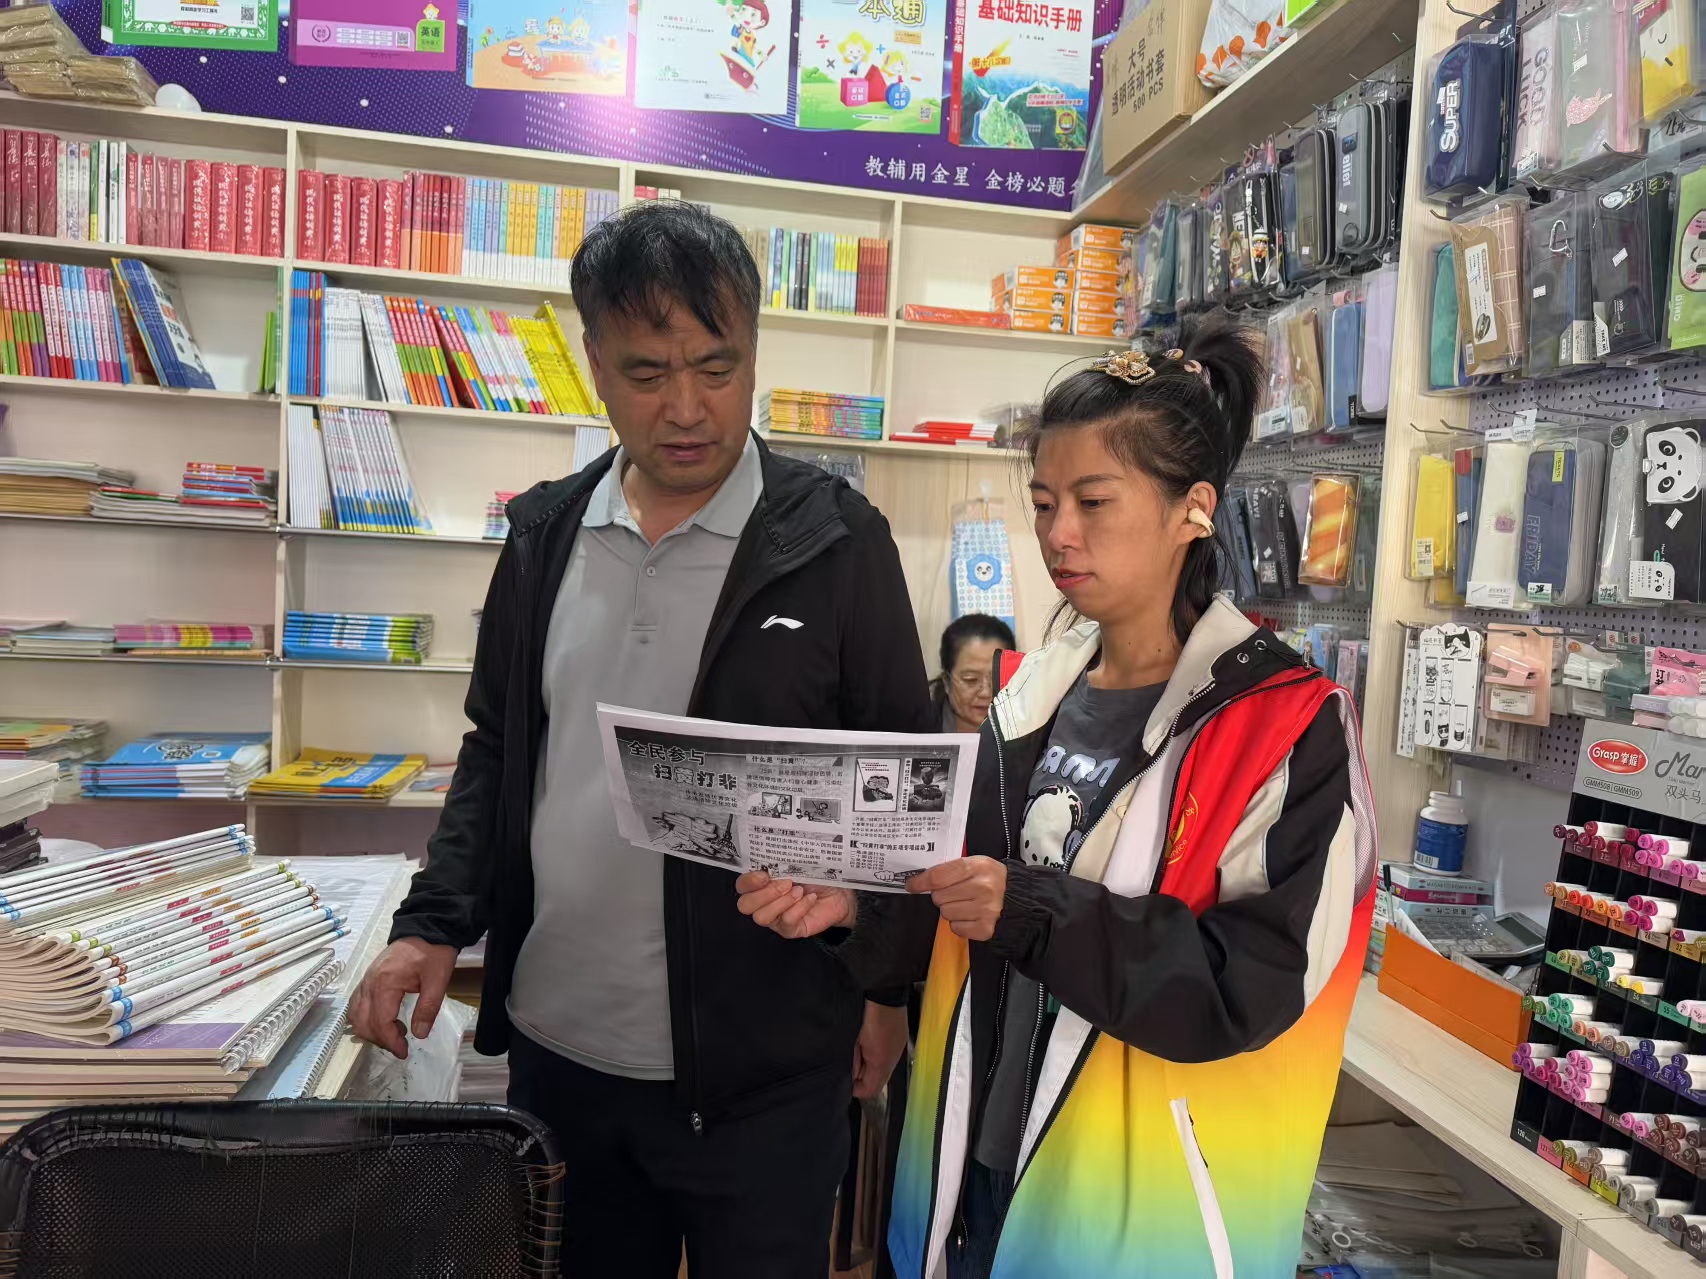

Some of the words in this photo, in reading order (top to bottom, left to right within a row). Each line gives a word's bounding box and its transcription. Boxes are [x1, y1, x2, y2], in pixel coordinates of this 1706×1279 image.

[421, 26, 440, 37] 英语
[978, 0, 1083, 32] 基础知识手册
[1128, 37, 1146, 73] 大号
[1112, 49, 1164, 116] 透明活动书套
[1133, 93, 1146, 112] 500
[1149, 77, 1163, 100] PCS
[1439, 79, 1460, 152] SUPER
[865, 155, 970, 186] 教辅用金星
[1524, 515, 1541, 574] FRIDAY
[629, 741, 705, 766] 全民参与
[1592, 747, 1620, 762] Grasp
[653, 764, 737, 790] 扫黄打非
[1585, 778, 1611, 791] GMM508
[1613, 786, 1640, 798] GMM509
[1665, 785, 1706, 804] 双头马
